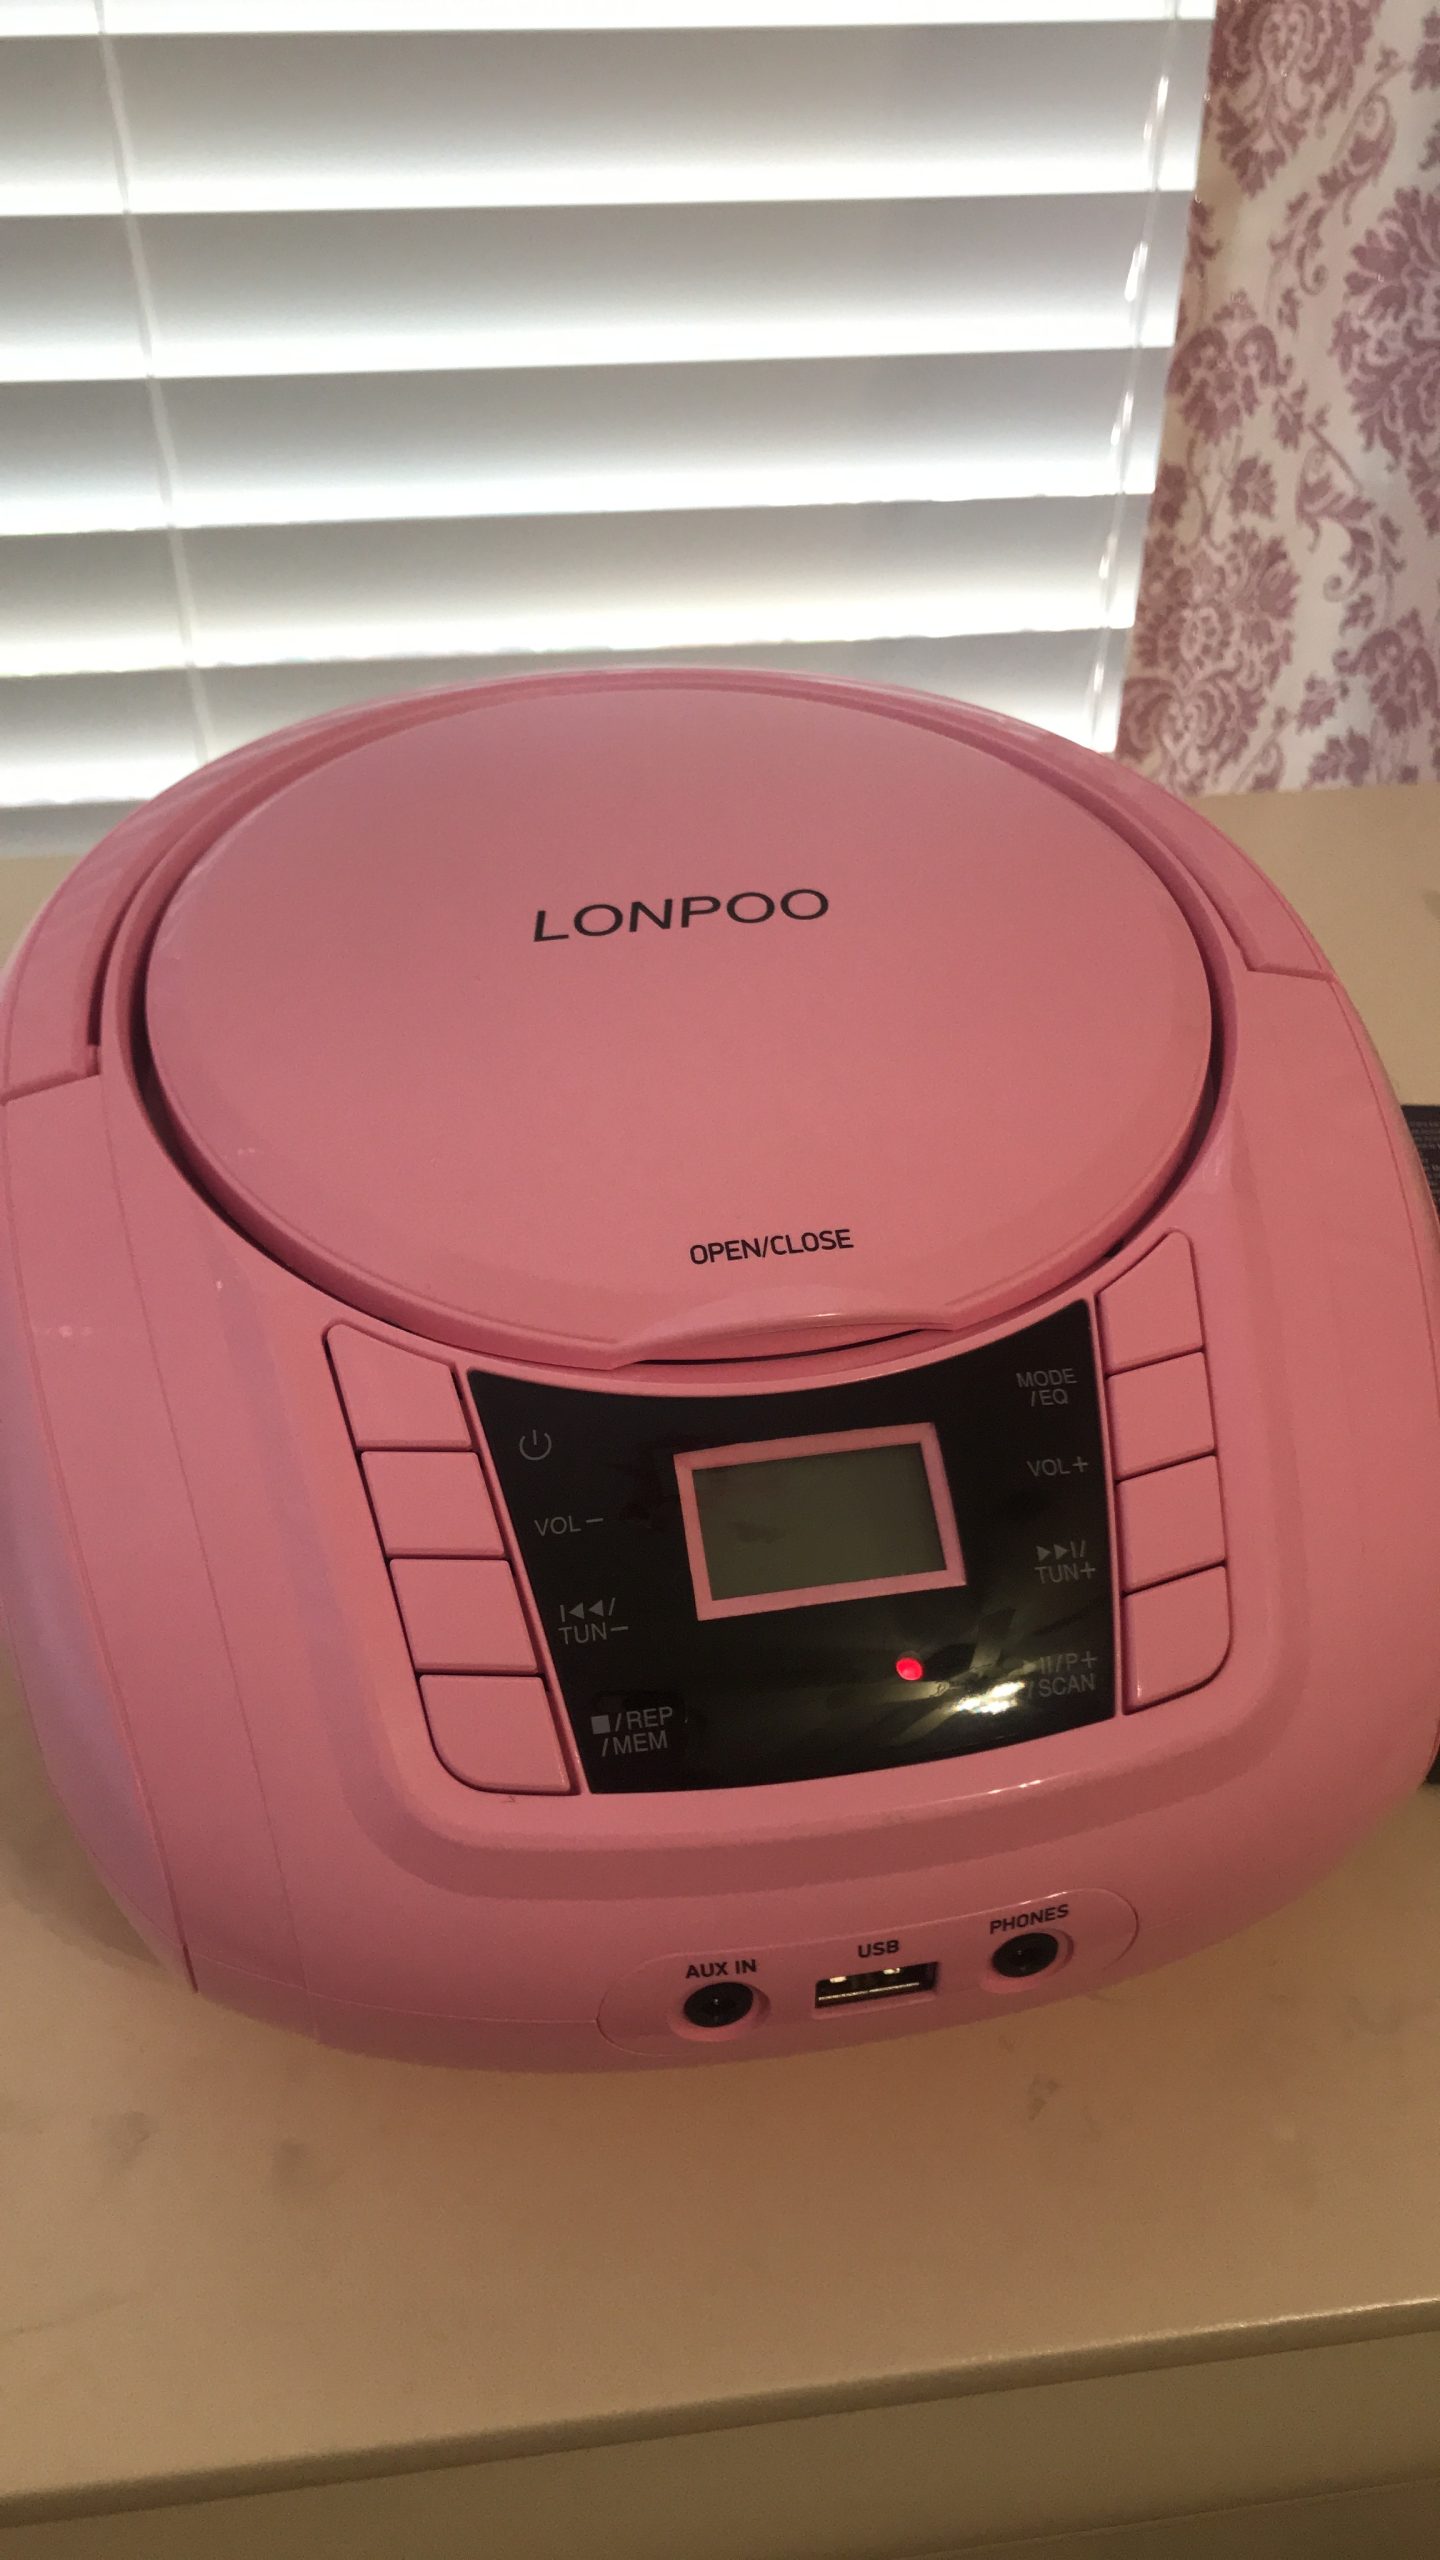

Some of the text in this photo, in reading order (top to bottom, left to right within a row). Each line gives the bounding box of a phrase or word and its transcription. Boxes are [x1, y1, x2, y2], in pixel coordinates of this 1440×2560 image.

[533, 888, 829, 942] LONPOO
[689, 1229, 854, 1265] OPEN/CLOSE
[1016, 1367, 1078, 1388] MODE
[989, 1904, 1070, 1935] PHONES
[857, 1939, 900, 1959] USB
[685, 1958, 758, 1980] AUX IN
